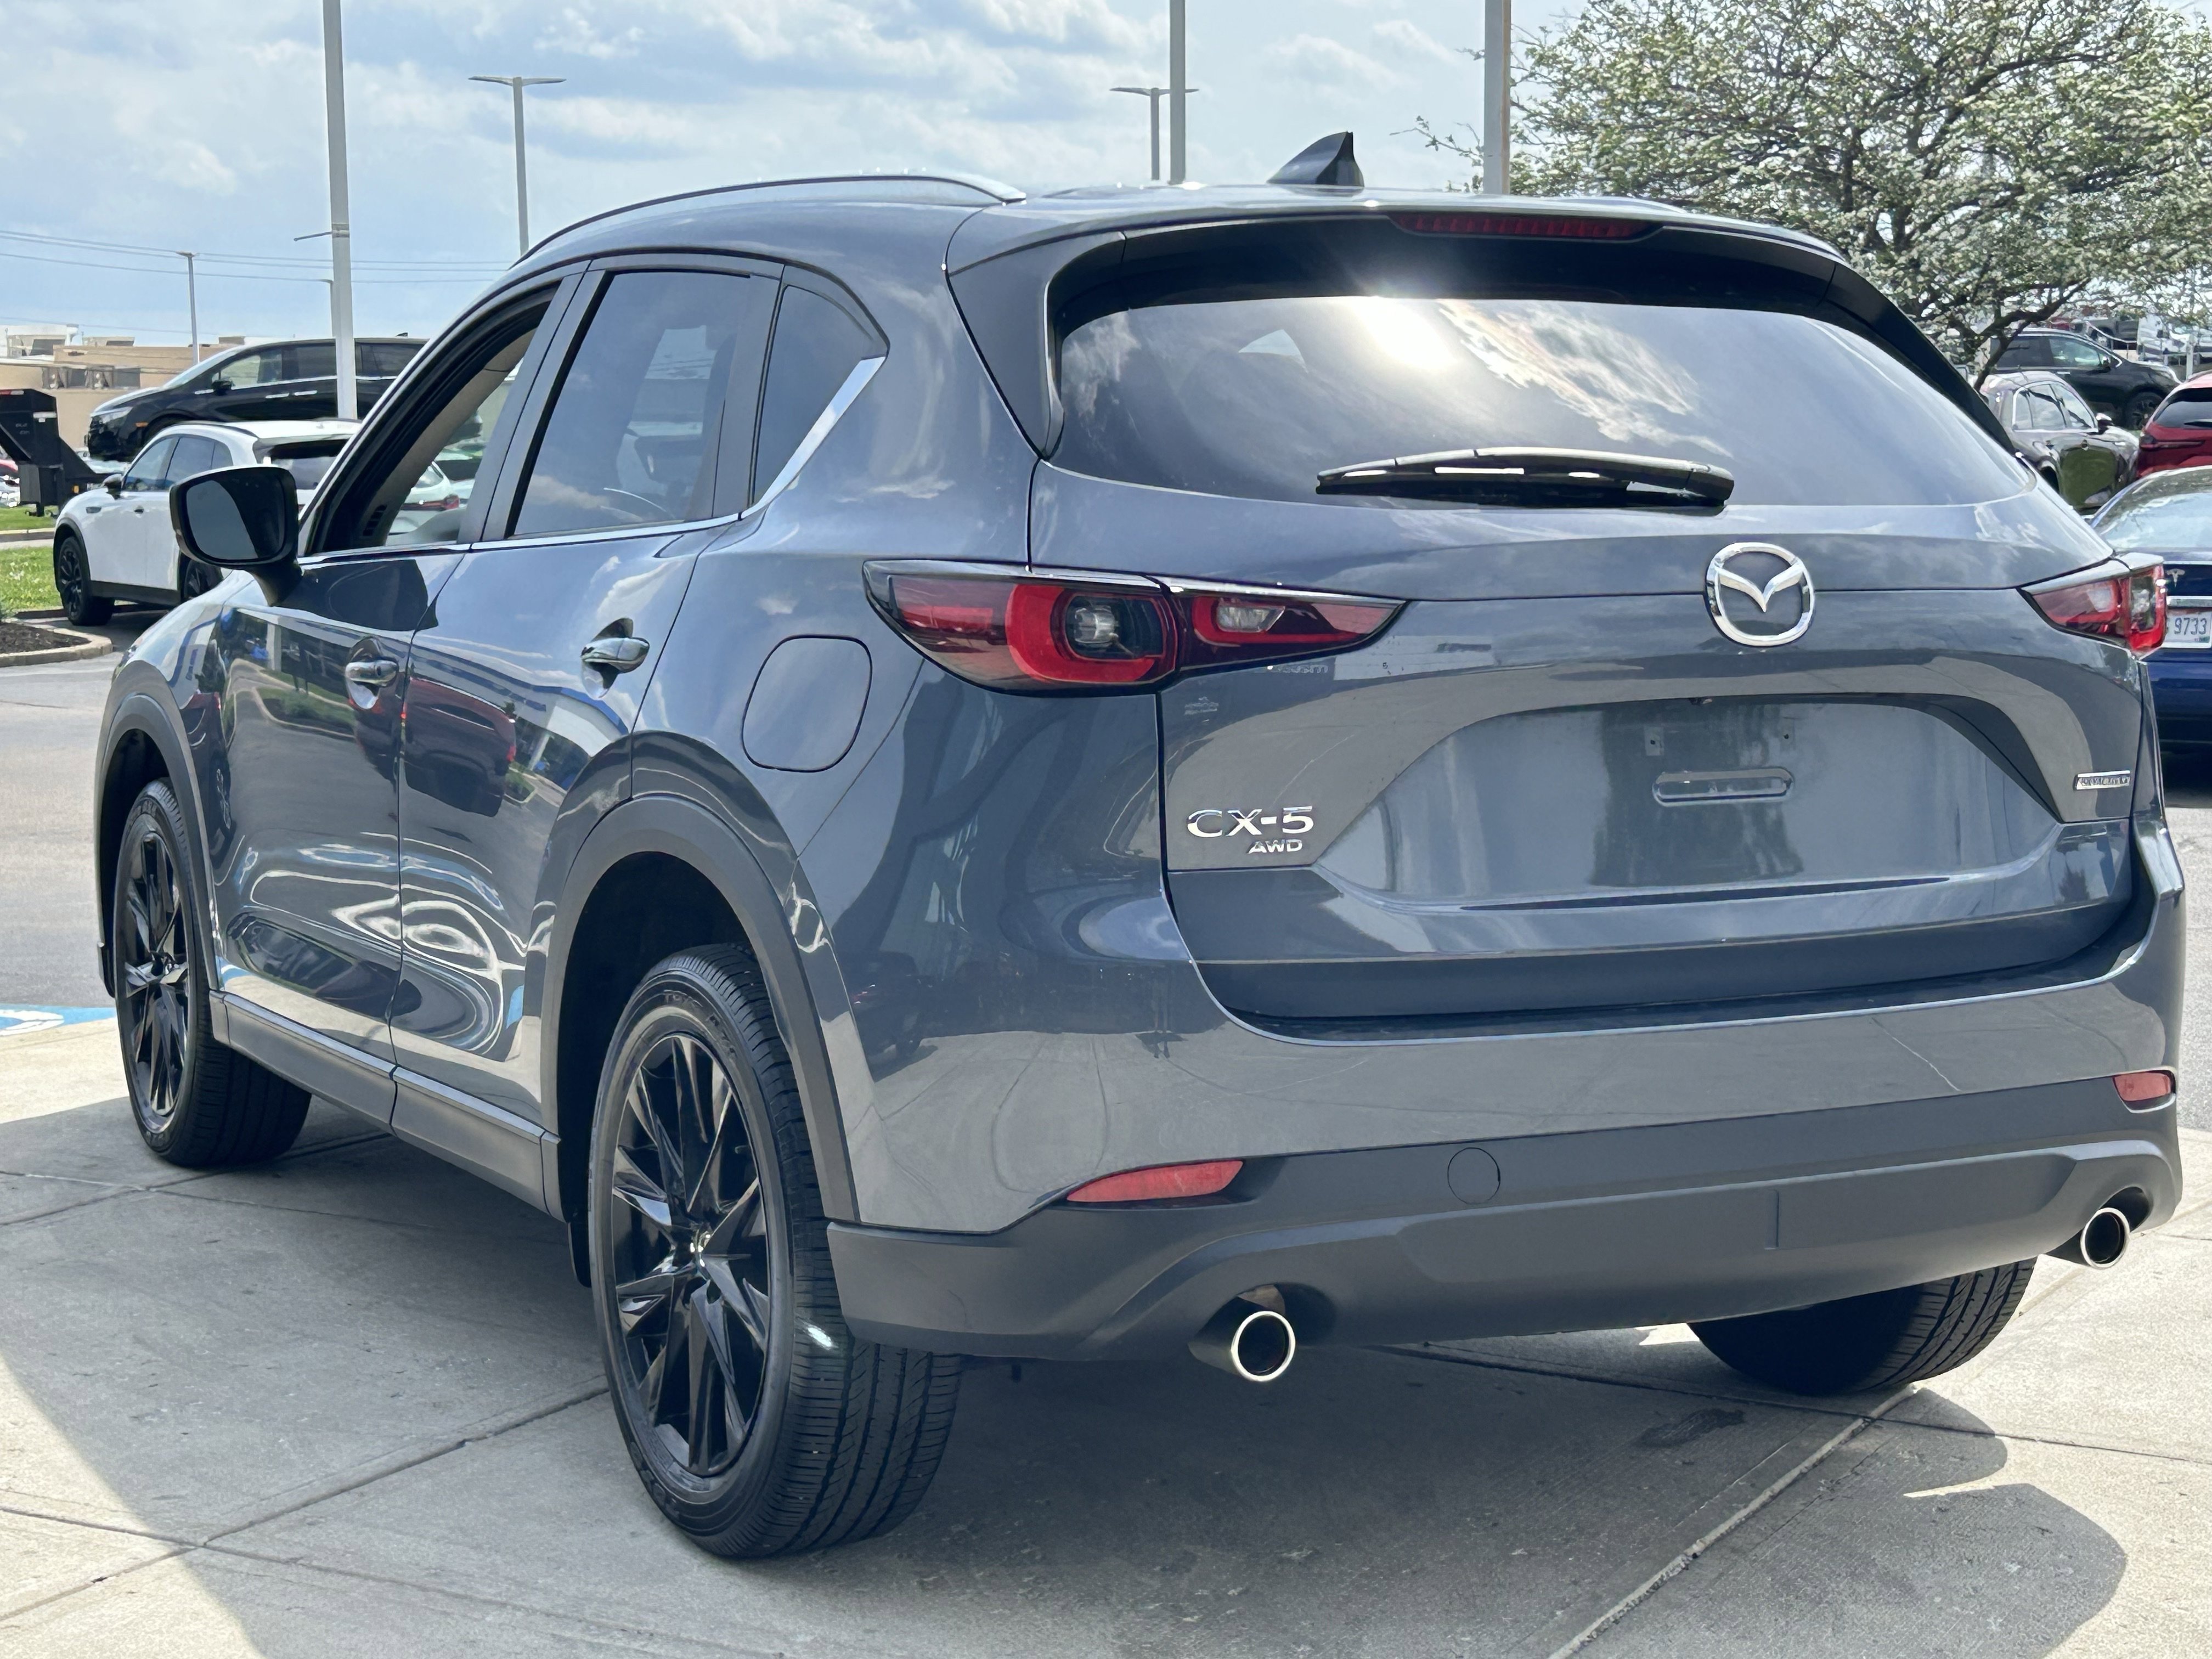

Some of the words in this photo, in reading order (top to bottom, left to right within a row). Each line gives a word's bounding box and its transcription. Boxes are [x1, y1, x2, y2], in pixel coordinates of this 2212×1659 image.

[2174, 617, 2207, 636] 9733
[1187, 806, 1314, 838] CX-5
[1246, 839, 1303, 854] AWD
